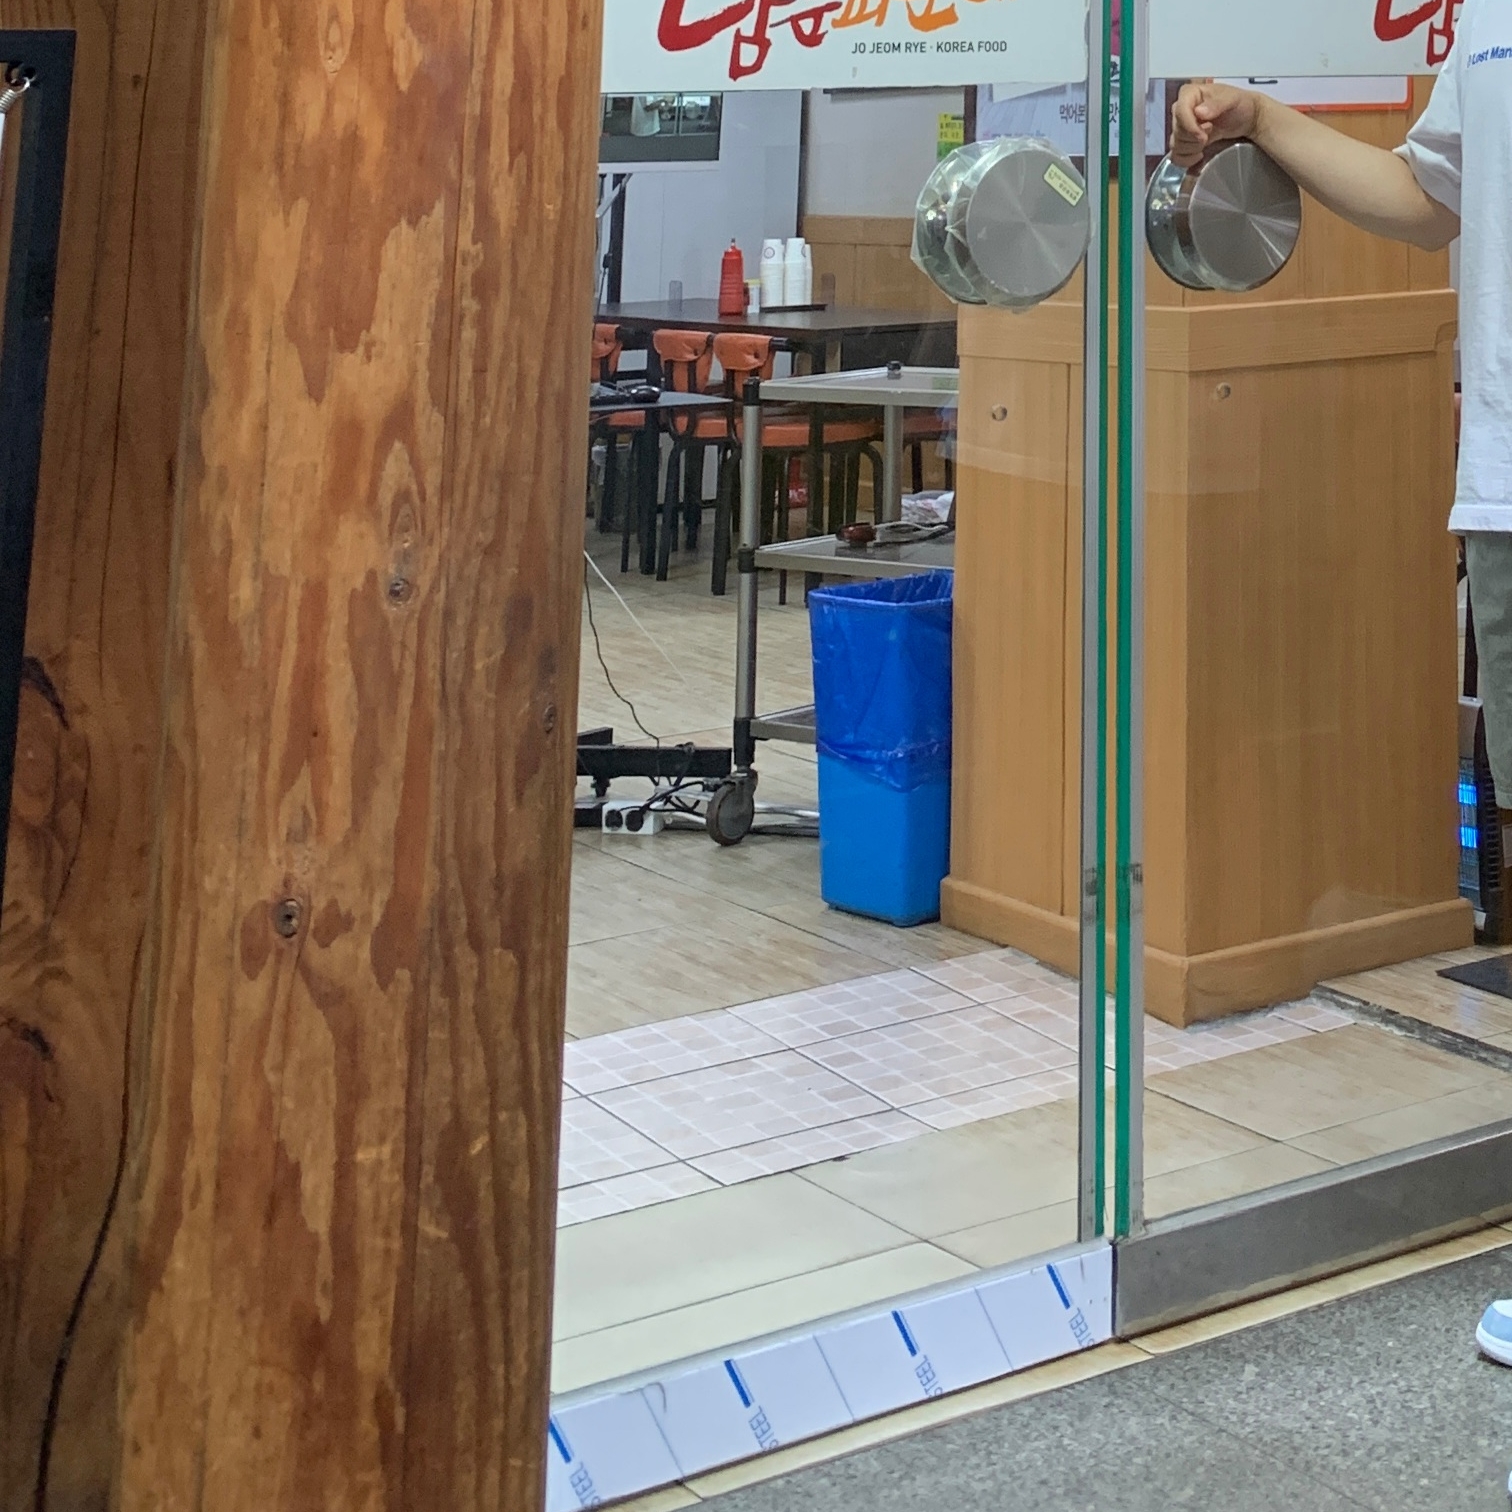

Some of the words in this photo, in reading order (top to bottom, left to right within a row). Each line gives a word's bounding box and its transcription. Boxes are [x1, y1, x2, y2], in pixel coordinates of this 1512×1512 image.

[851, 41, 867, 54] JO
[869, 41, 901, 54] JEOM
[904, 41, 927, 54] RYE
[936, 41, 975, 54] KOREA
[977, 41, 1007, 54] FOOD
